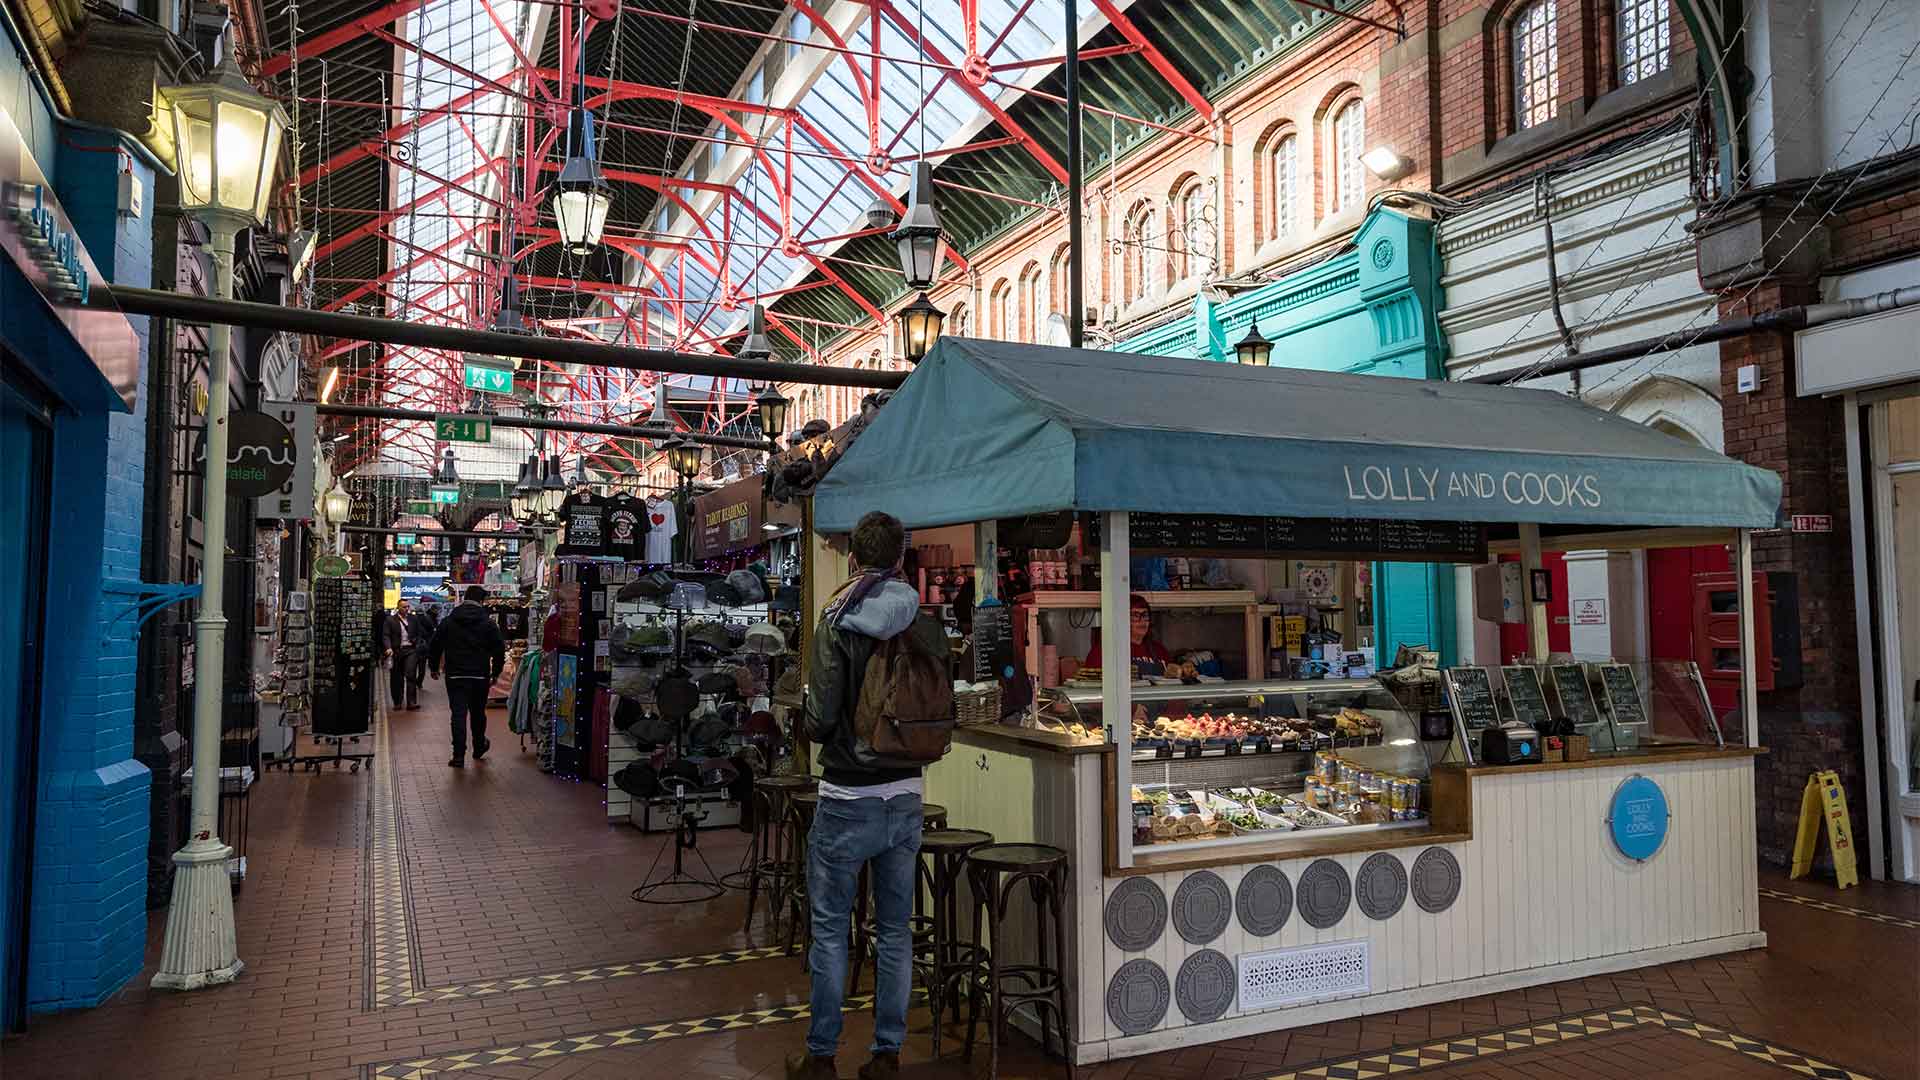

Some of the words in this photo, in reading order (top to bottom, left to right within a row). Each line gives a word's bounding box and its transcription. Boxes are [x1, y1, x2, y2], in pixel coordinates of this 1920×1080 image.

[1343, 464, 1439, 502] LOLLY
[1447, 471, 1495, 499] AND
[1502, 471, 1601, 508] COOKS
